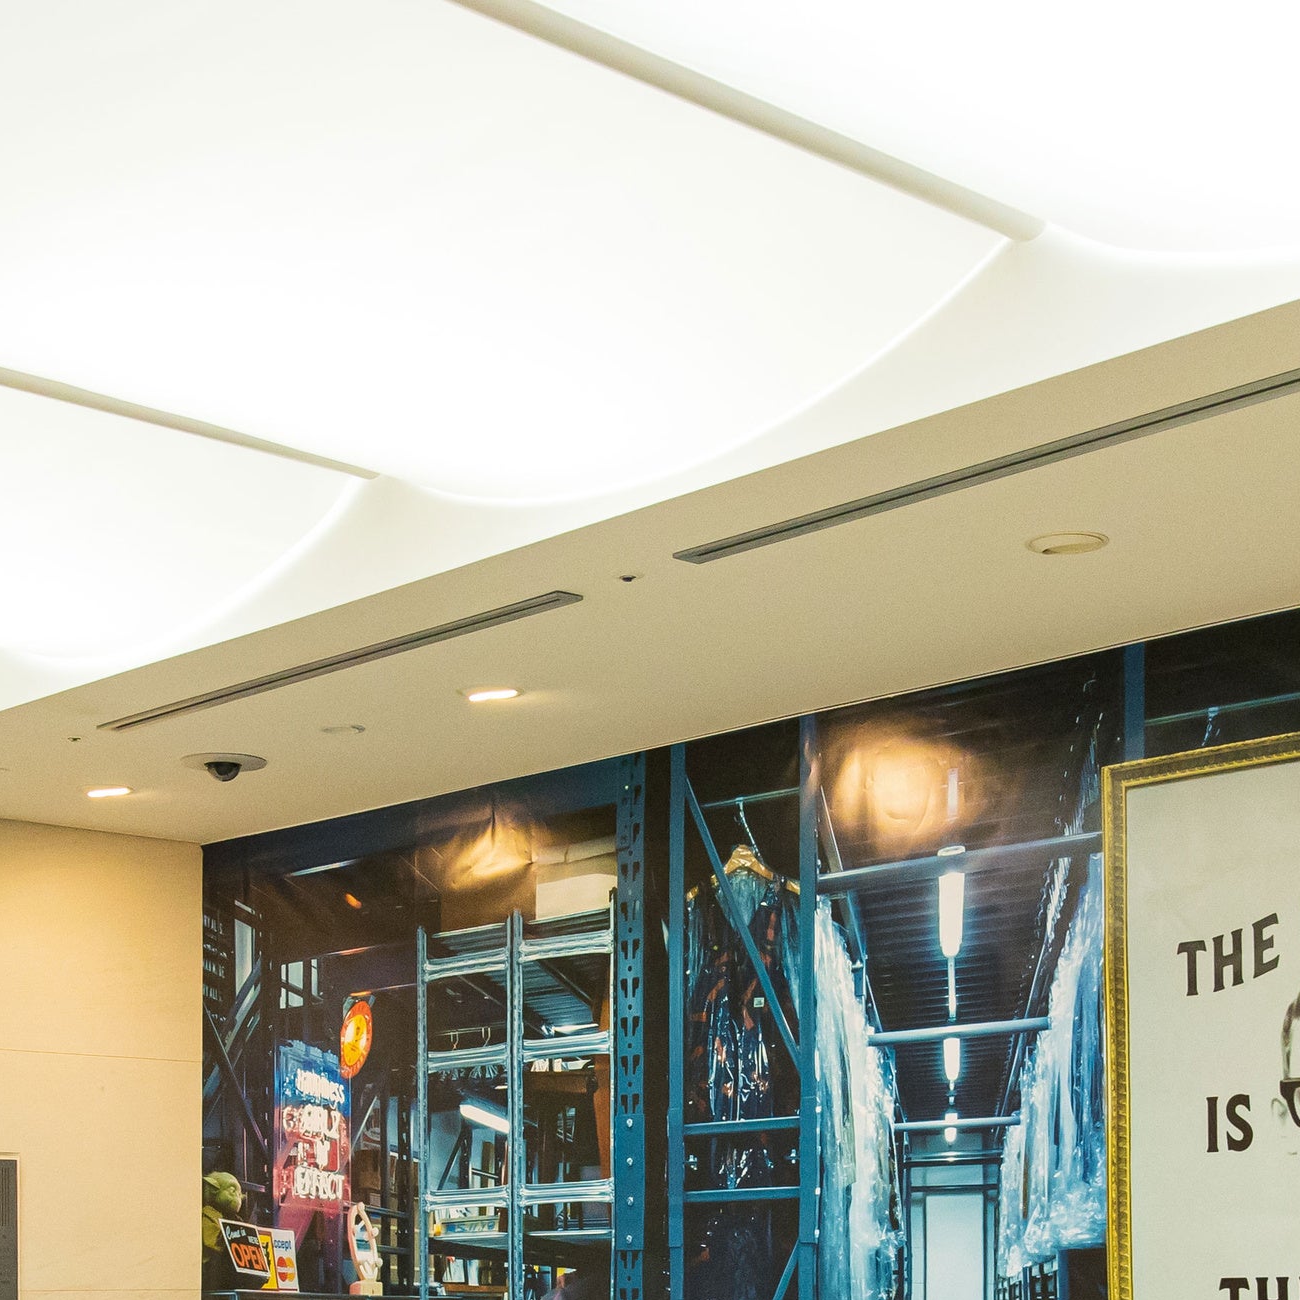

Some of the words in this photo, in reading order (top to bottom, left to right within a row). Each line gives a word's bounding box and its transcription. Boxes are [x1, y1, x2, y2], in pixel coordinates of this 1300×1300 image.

[1177, 912, 1280, 996] THE
[1206, 1094, 1254, 1153] IS
[231, 1242, 267, 1271] OPEN
[274, 1239, 292, 1252] ccept
